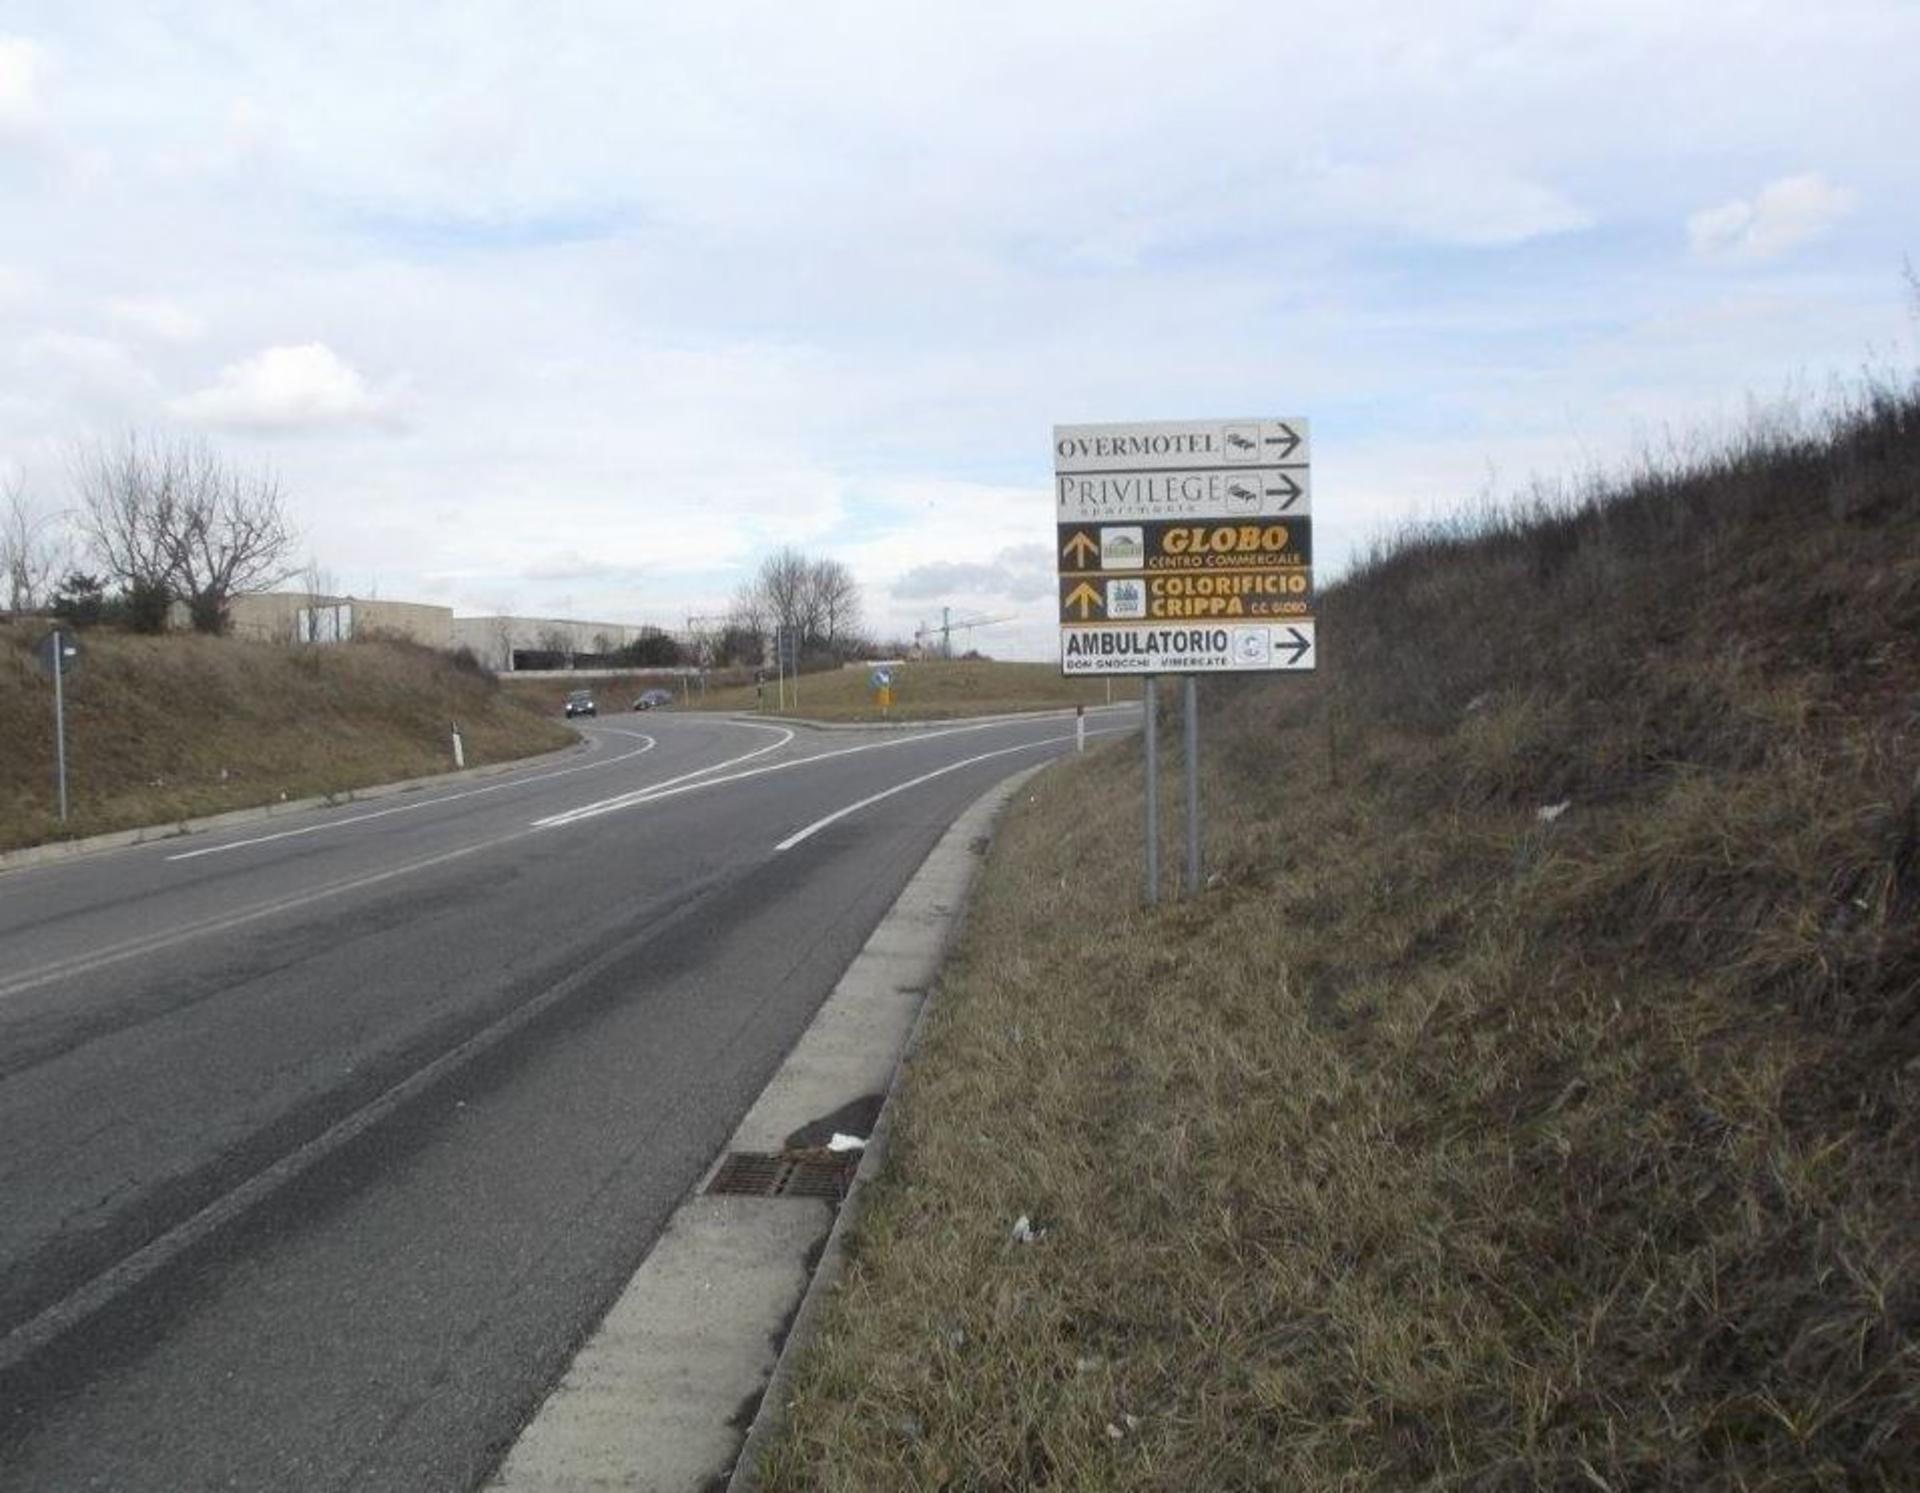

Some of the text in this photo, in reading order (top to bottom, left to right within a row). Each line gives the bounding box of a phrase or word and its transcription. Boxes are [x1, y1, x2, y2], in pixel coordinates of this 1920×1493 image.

[1058, 434, 1220, 458] OVERMOTEL
[1060, 475, 1222, 506] PRIVILEGE
[1162, 526, 1289, 553] GLOBO
[1149, 553, 1301, 568] CENTRO COMMERCIALE
[1151, 575, 1306, 595] COLORIFICIO
[1152, 596, 1243, 617] CRIPPA
[1067, 630, 1228, 656] AMBULATORIO
[1067, 656, 1228, 670] DON GNOCCHI VIMERCATE
